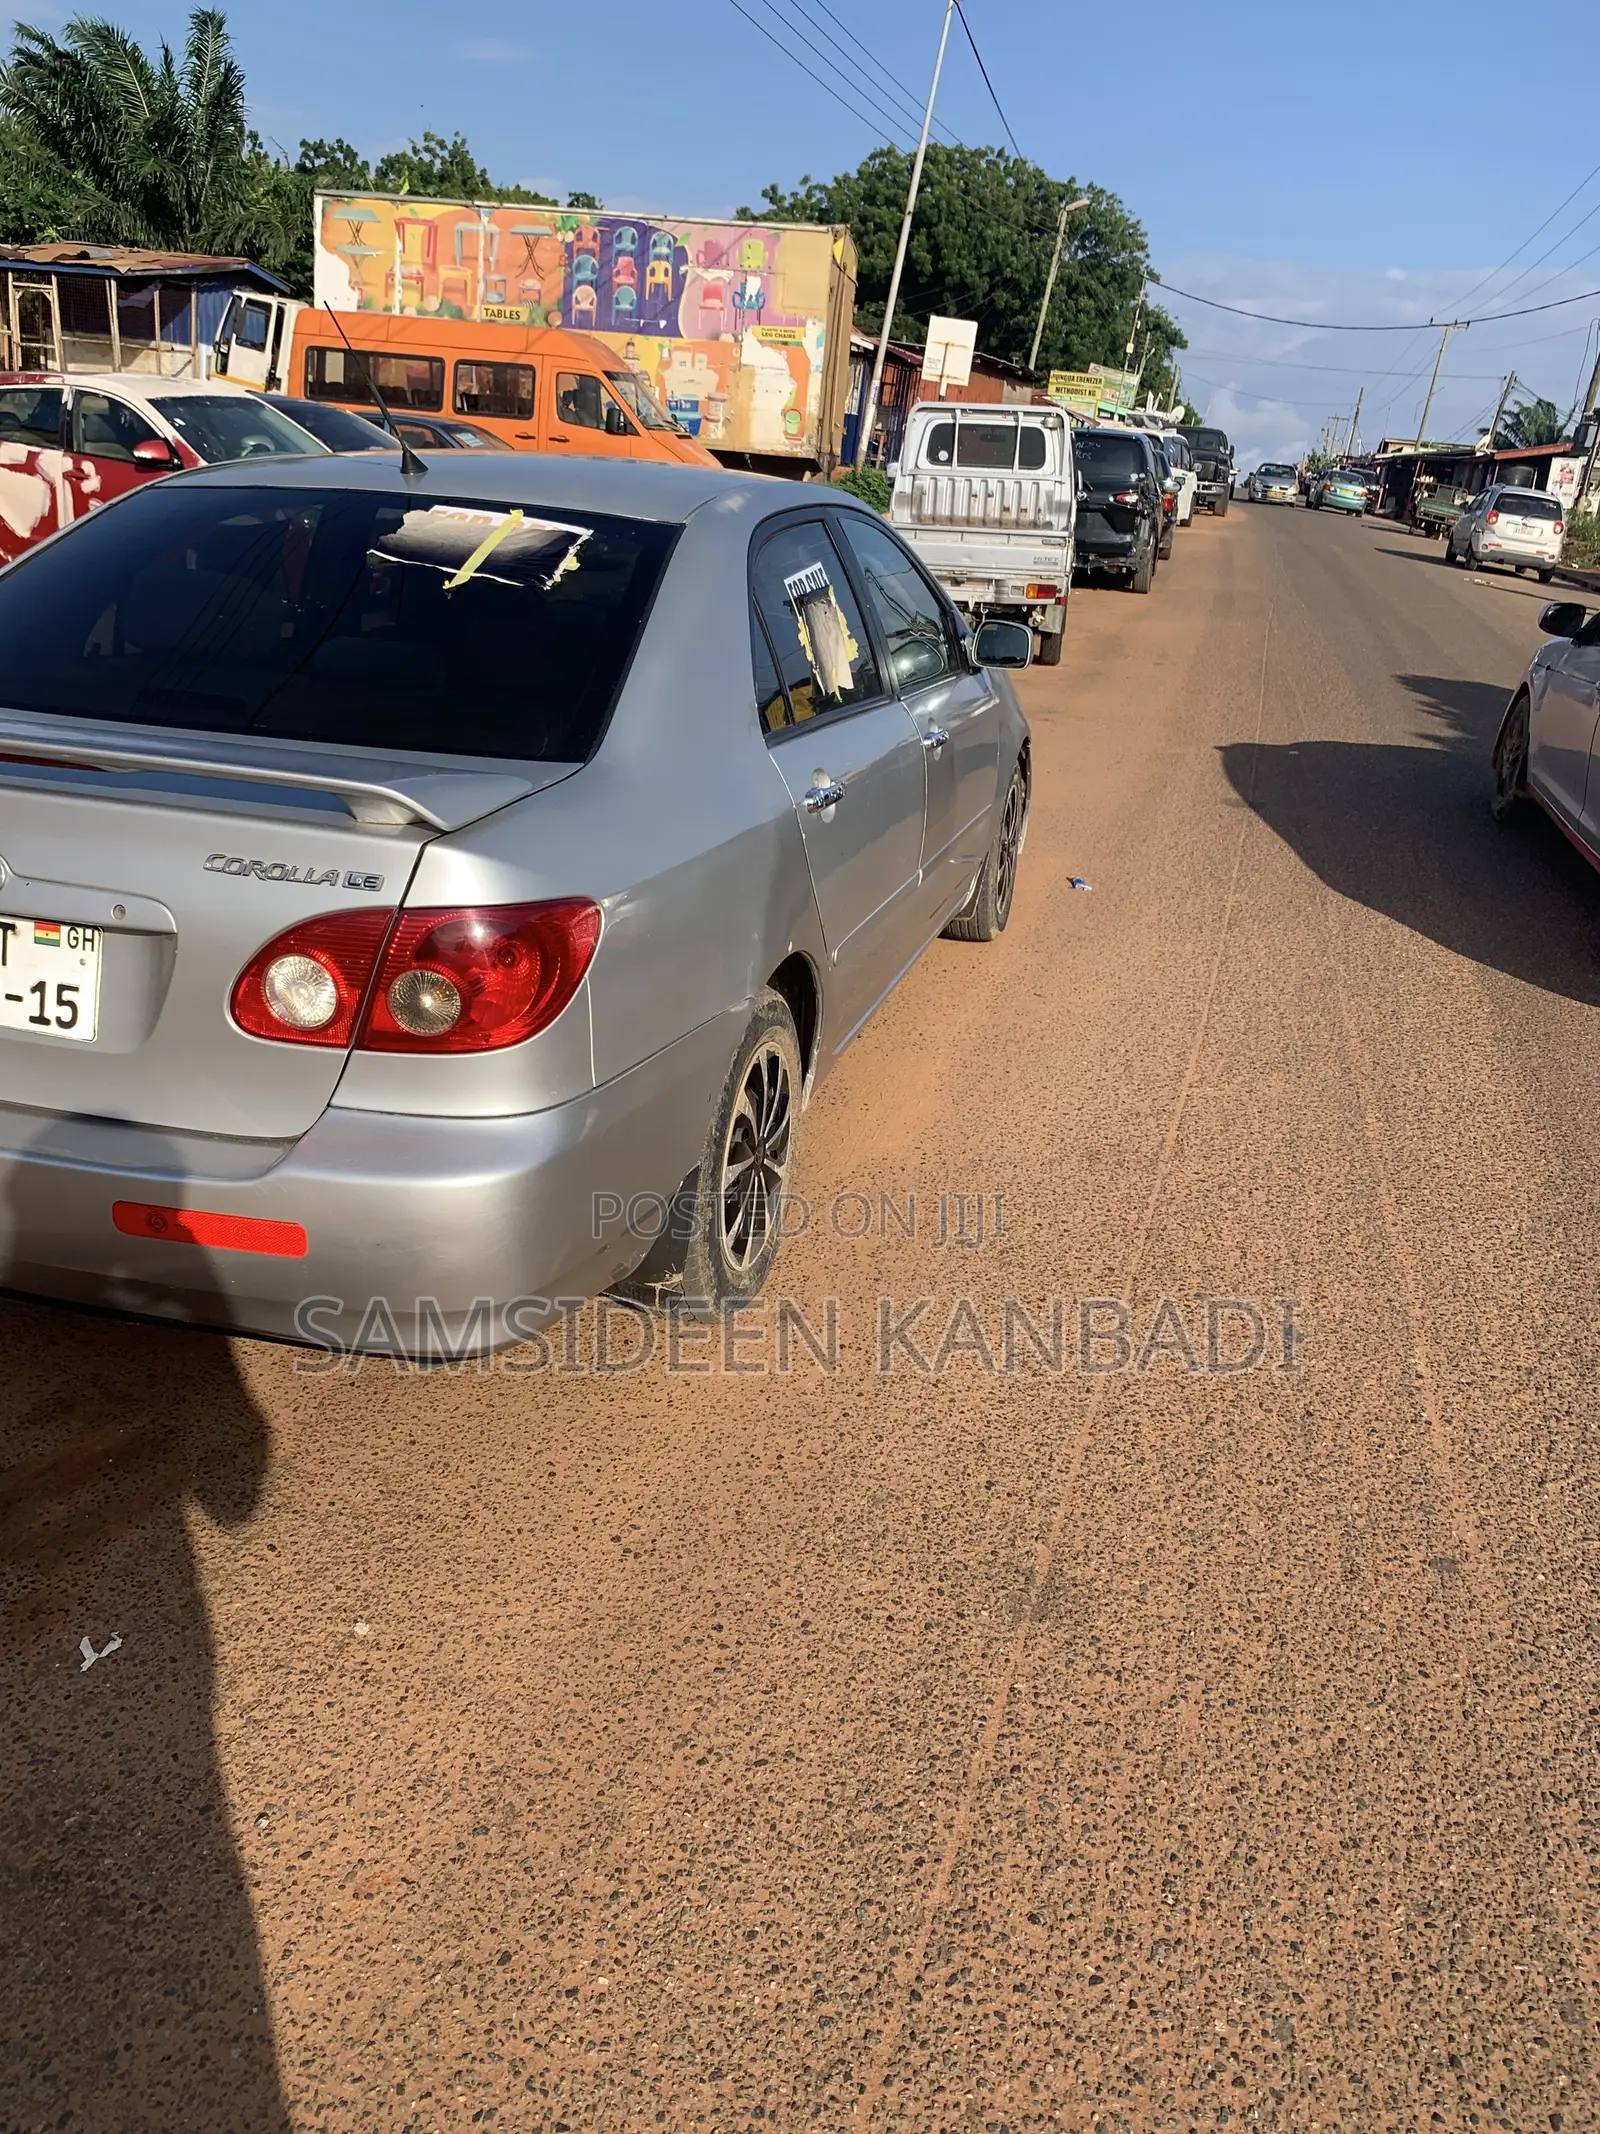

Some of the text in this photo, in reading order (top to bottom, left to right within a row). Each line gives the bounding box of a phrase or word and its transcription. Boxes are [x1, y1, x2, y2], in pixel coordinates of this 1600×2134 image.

[483, 307, 521, 321] TABLES
[1076, 374, 1102, 385] EBENEZER
[1055, 386, 1087, 396] METHODIST
[202, 853, 381, 890] COROLLA LE
[67, 926, 95, 952] GH
